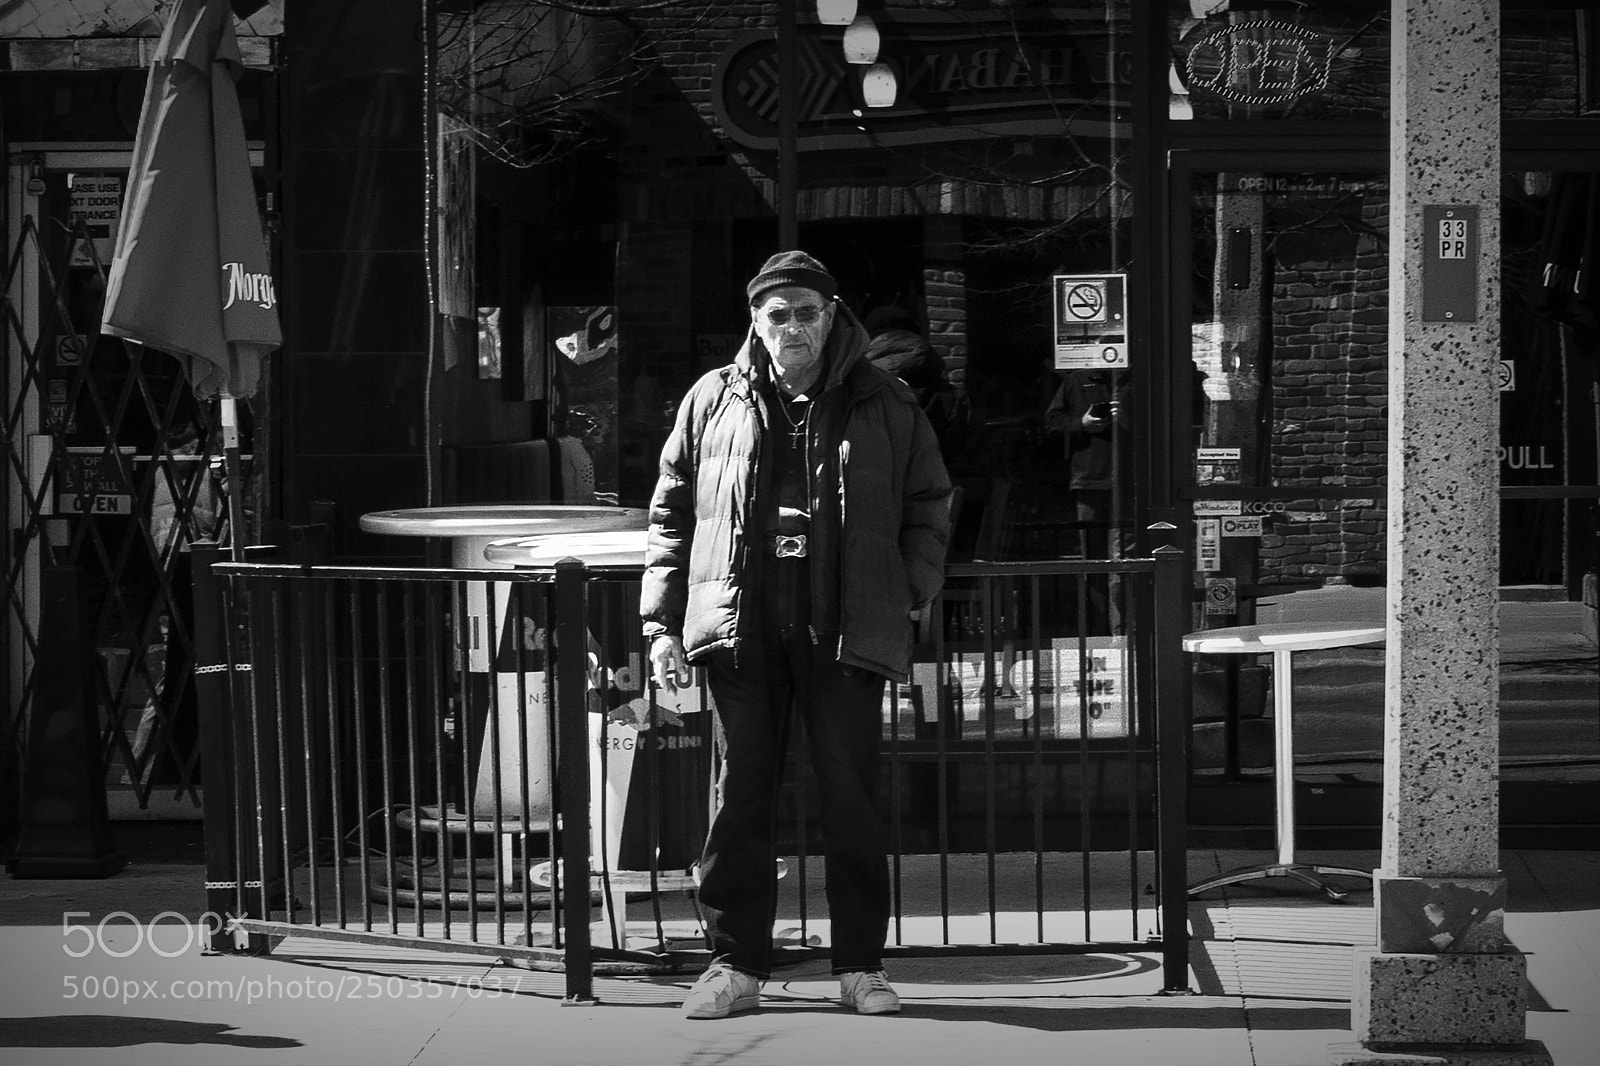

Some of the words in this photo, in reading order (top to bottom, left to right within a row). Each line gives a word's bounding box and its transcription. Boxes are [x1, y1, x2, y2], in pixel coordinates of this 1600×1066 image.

[98, 184, 118, 192] USE
[1238, 177, 1273, 191] OPEN
[88, 197, 117, 206] DOOR
[1442, 241, 1464, 257] PR
[73, 496, 118, 512] OEN
